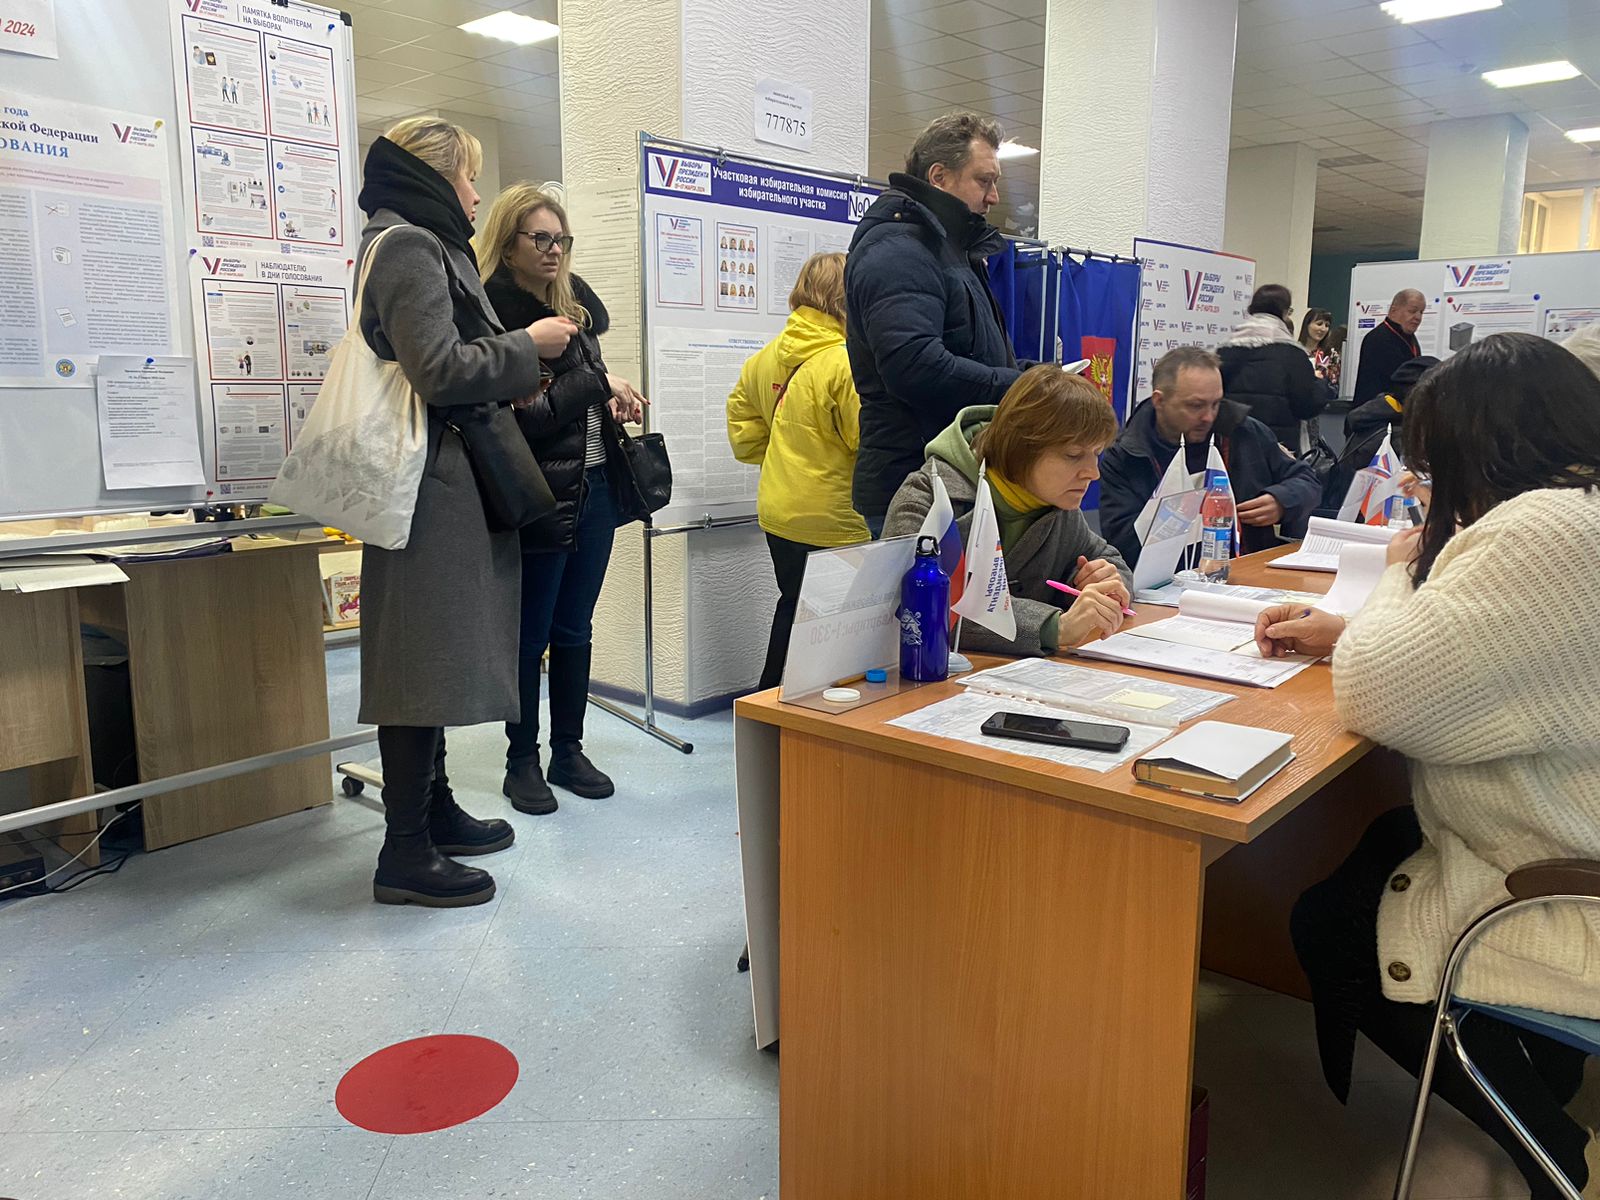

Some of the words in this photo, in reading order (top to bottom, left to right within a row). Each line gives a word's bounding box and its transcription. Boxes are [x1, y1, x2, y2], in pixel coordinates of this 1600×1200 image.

[242, 5, 272, 19] ПАМЯТКА
[273, 14, 313, 29] ВОЛОНТЕРАМ
[242, 15, 252, 24] НА
[253, 18, 282, 31] ВЫБОРАХ
[4, 19, 35, 37] 2024
[4, 106, 29, 117] года
[0, 120, 26, 131] кой
[29, 123, 99, 143] Федерации
[765, 112, 806, 137] 777875
[680, 160, 703, 169] ВЫБОРЫ
[675, 175, 696, 184] РОССИИ
[678, 168, 709, 178] ПРЕЗИДЕНТА
[712, 166, 758, 186] Участковая
[760, 177, 814, 195] избирательная
[816, 188, 848, 201] комиссия
[739, 186, 798, 206] избирательного
[799, 197, 827, 211] участка
[260, 261, 307, 272] НАБЛЮДАТЕЛЮ
[281, 272, 323, 282] ГОЛОСОВАНИЯ
